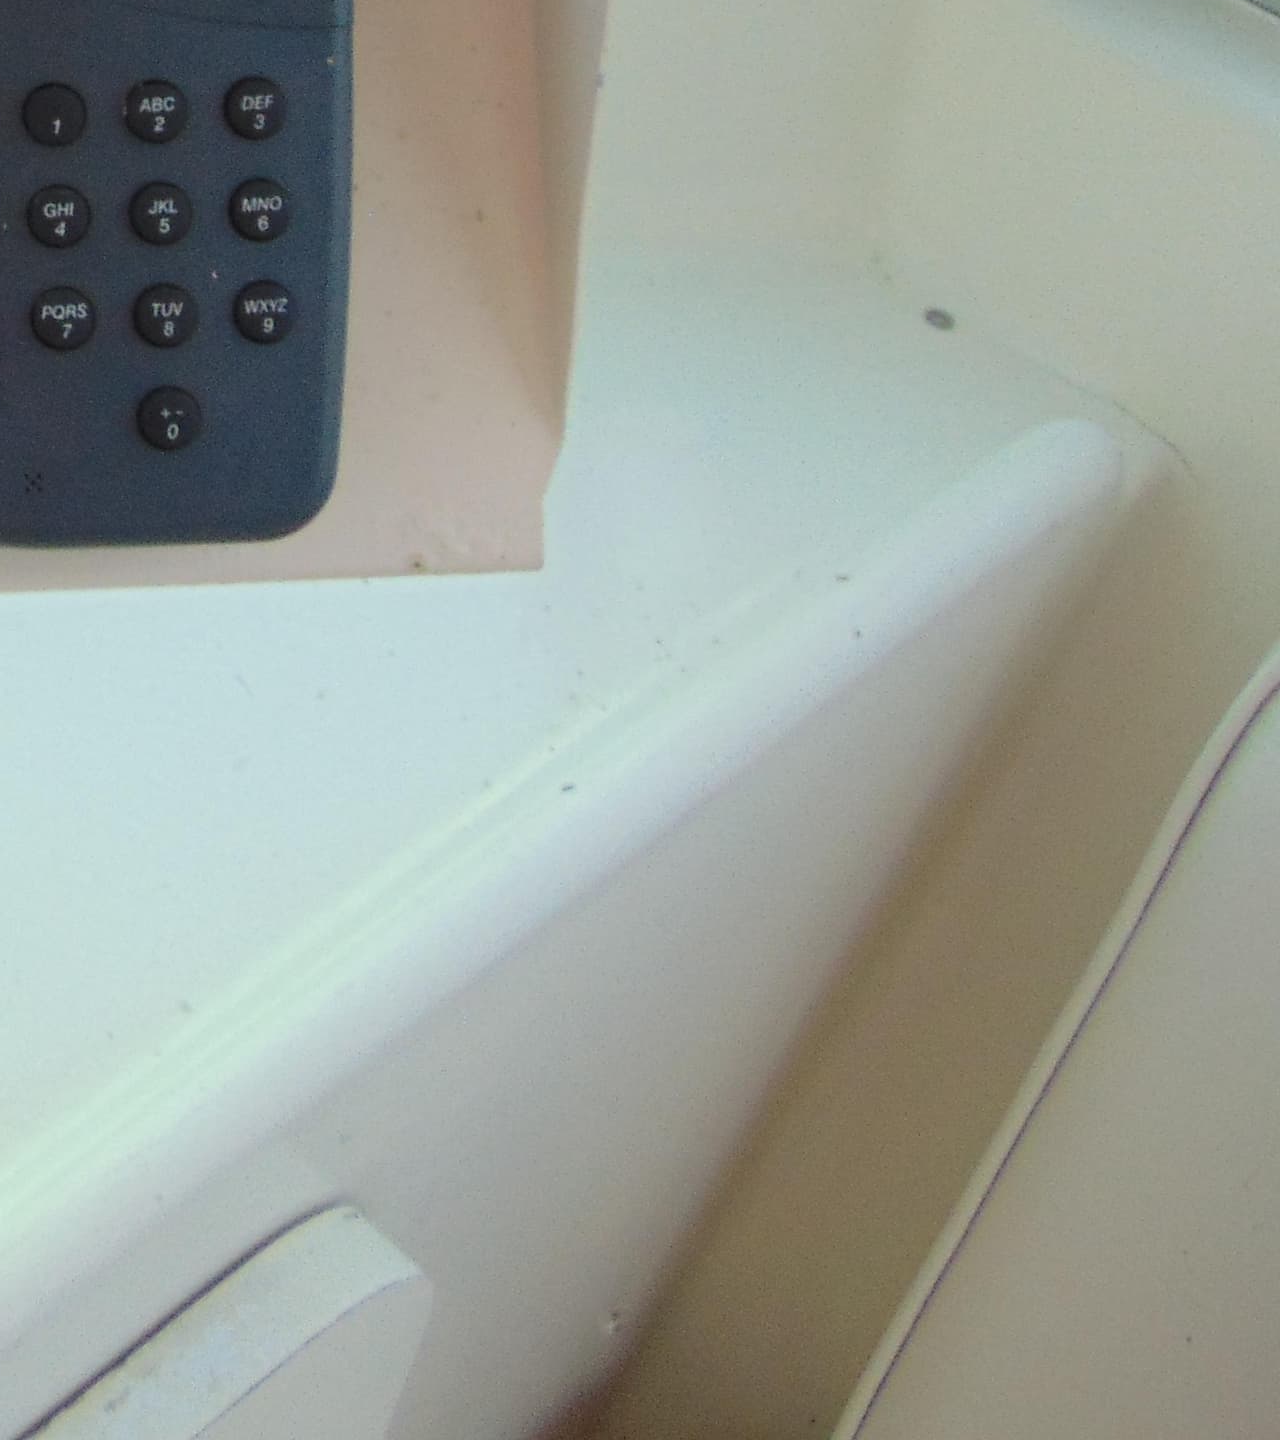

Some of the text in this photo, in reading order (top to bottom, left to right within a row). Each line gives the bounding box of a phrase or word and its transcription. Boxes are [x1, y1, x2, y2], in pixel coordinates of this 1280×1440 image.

[139, 97, 176, 113] ABC
[242, 95, 275, 112] DEF
[52, 119, 62, 136] 1
[153, 116, 167, 133] 2
[253, 114, 266, 130] 3
[43, 202, 75, 218] GHI
[148, 200, 179, 216] JKL
[241, 197, 283, 213] MNO
[54, 222, 67, 238] 4
[158, 219, 170, 235] 5
[256, 216, 269, 233] 6
[41, 303, 89, 321] PQRS
[151, 302, 185, 318] TUV
[243, 298, 289, 315] WXYZ
[60, 323, 73, 340] 7
[162, 322, 175, 338] 8
[262, 318, 275, 334] 9
[166, 424, 180, 441] 0
